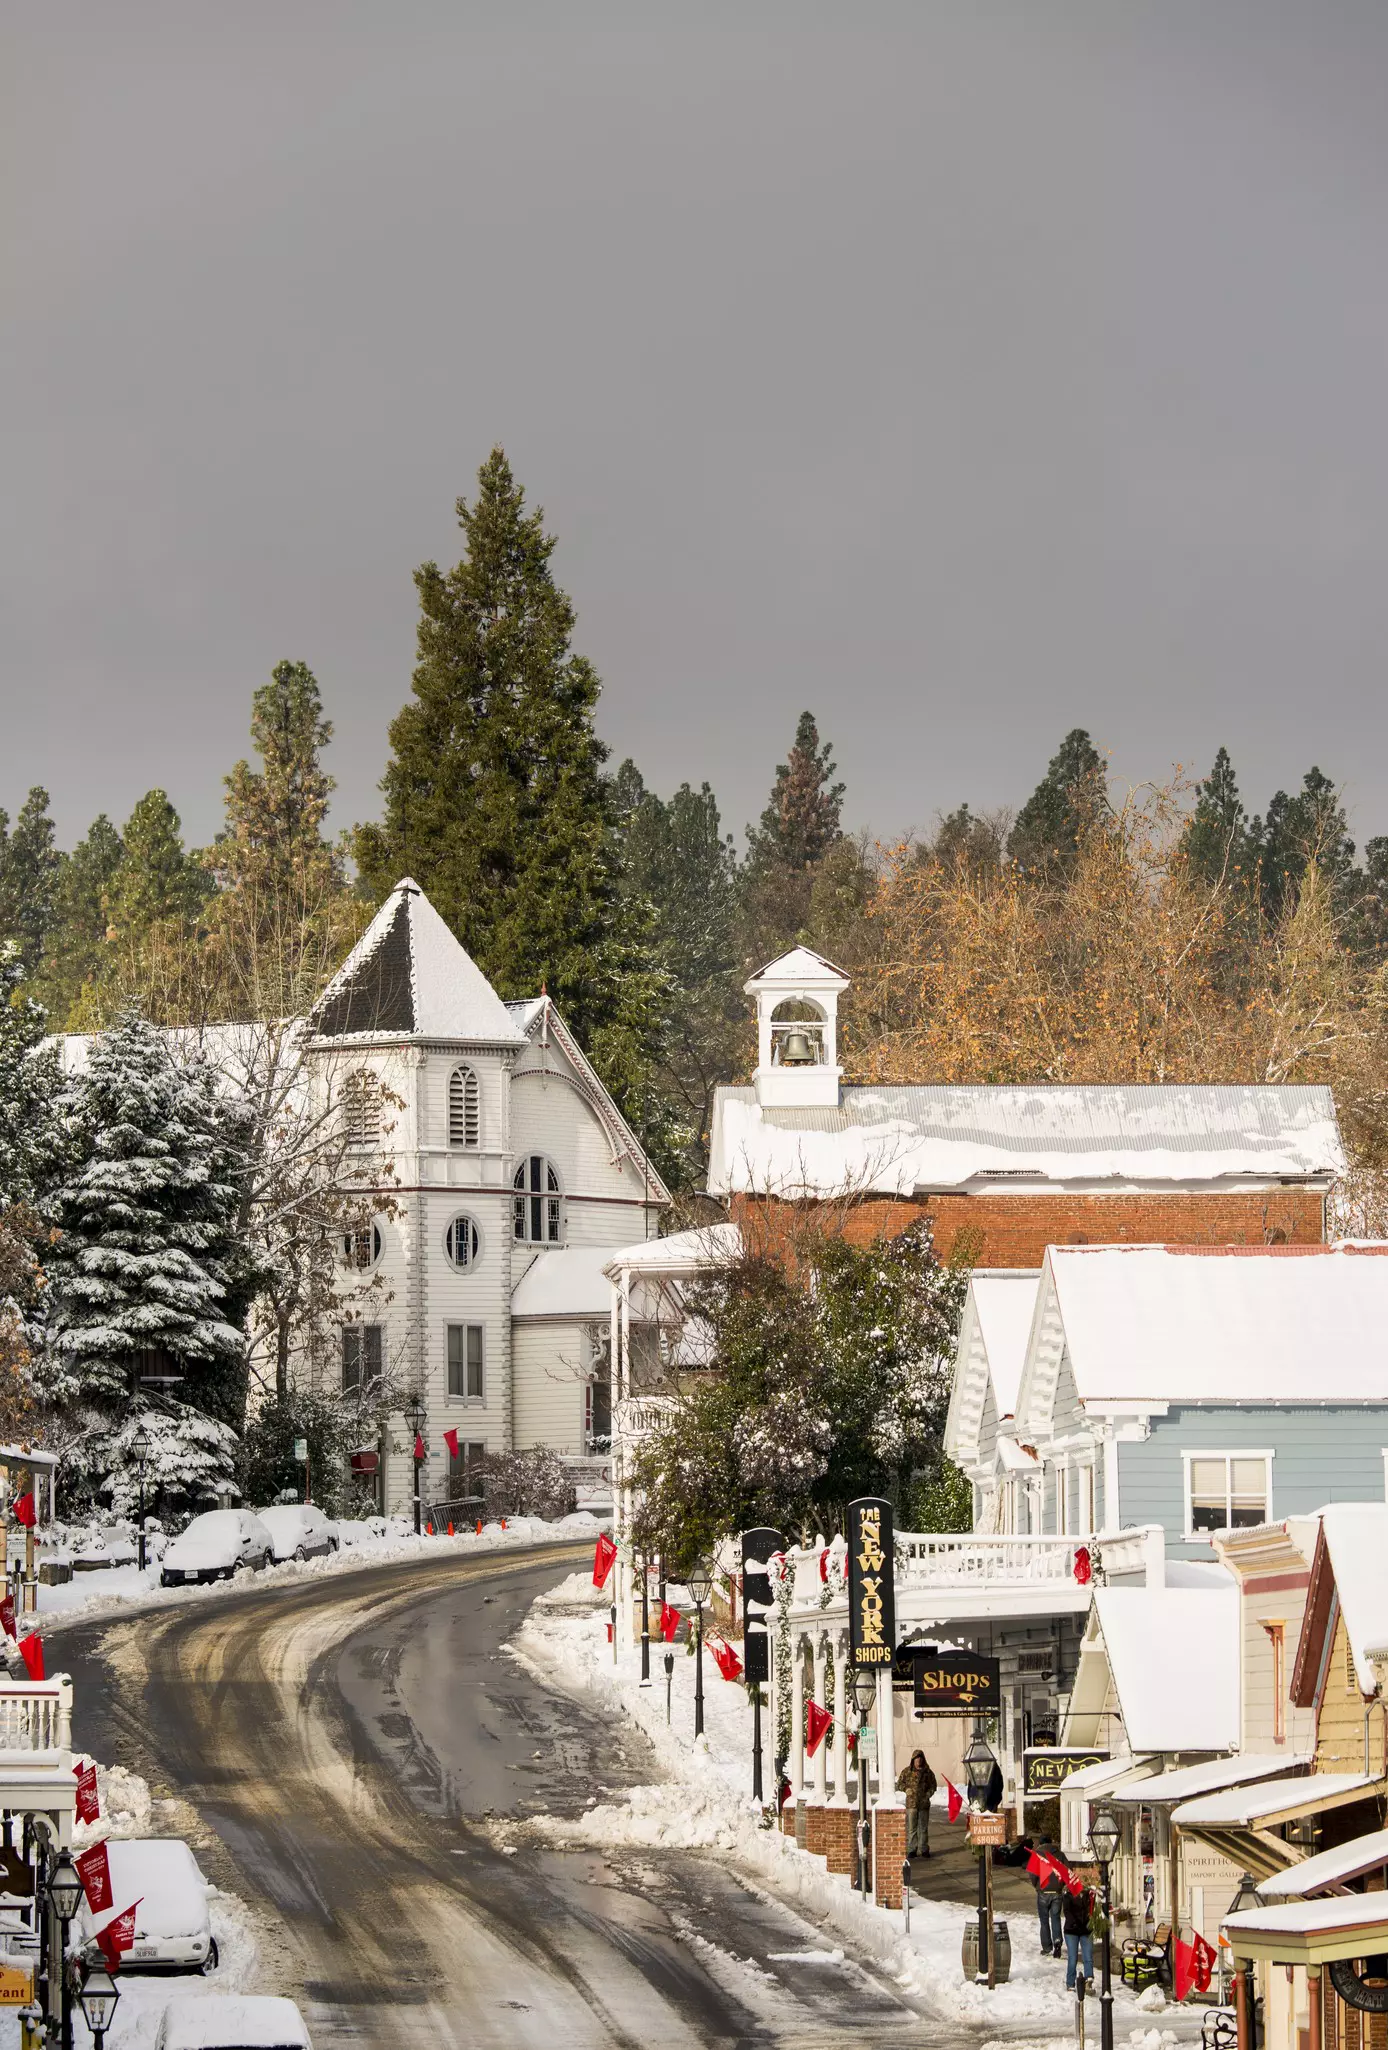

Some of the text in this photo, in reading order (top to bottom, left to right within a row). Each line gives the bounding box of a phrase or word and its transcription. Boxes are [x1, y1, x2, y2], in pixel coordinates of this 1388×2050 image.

[856, 1521, 886, 1572] NEW
[860, 1577, 885, 1644] YORK
[855, 1647, 891, 1663] SHOPS
[923, 1670, 990, 1692] Shops
[973, 1816, 981, 1825] TO
[973, 1825, 1003, 1835] PARKING
[977, 1835, 999, 1844] SHOPS
